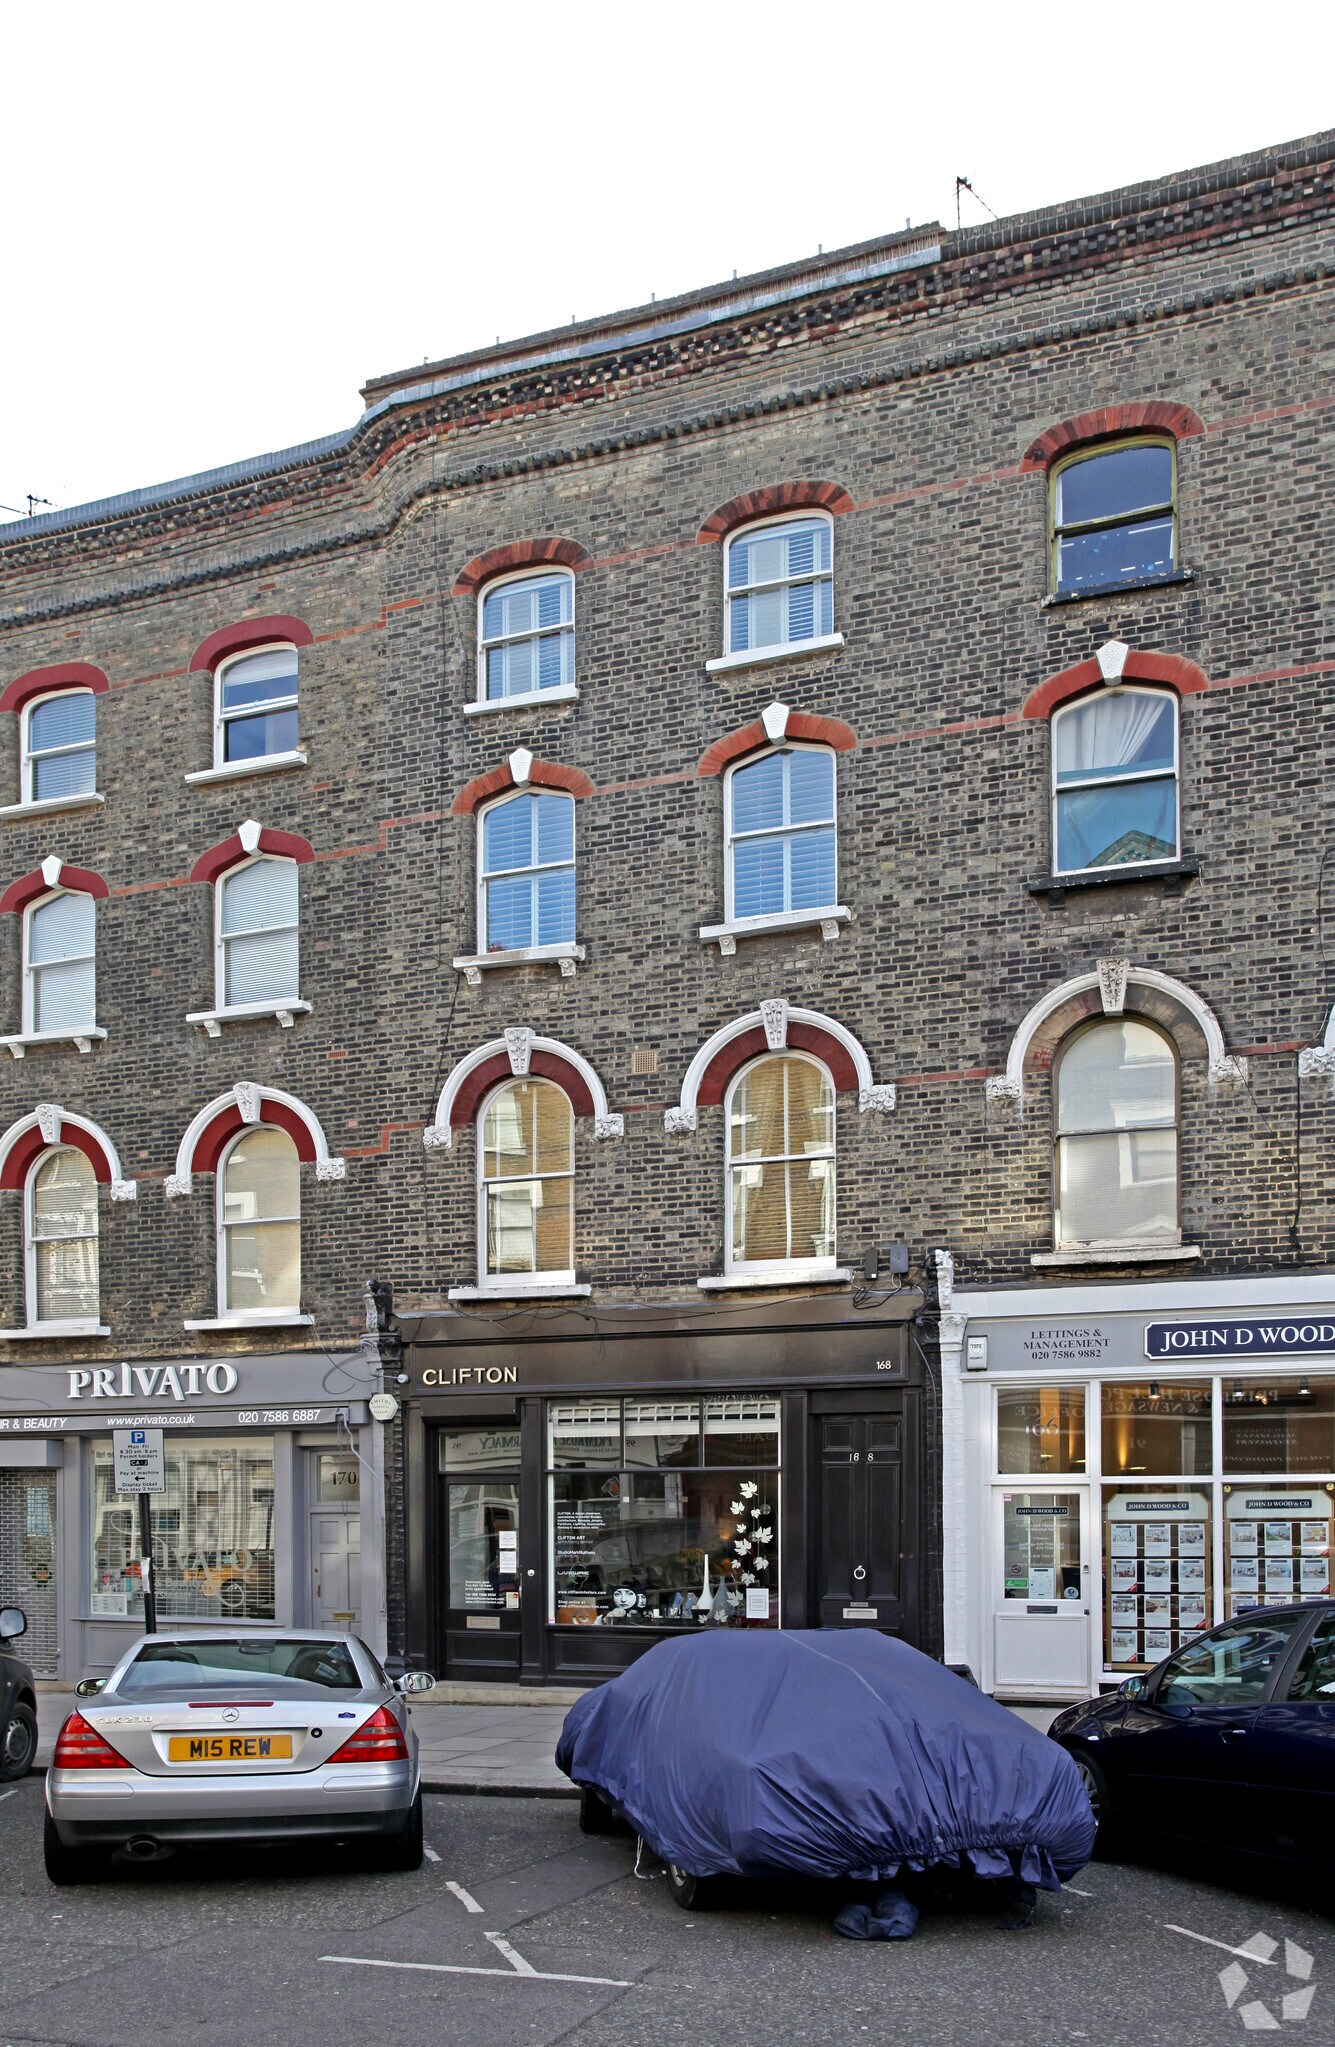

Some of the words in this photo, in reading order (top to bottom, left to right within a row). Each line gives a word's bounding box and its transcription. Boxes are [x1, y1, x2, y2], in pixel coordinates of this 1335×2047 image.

[1031, 1329, 1090, 1339] LETTINGS
[1093, 1328, 1102, 1337] &
[1160, 1329, 1228, 1352] JOHN
[1234, 1328, 1254, 1344] D
[1258, 1325, 1335, 1344] WOOD
[1024, 1338, 1110, 1350] MANAGEMENT
[1032, 1352, 1049, 1360] 020
[1052, 1350, 1075, 1359] 7586
[1078, 1350, 1101, 1358] 9882
[876, 1360, 892, 1370] 168
[66, 1362, 238, 1401] PRIVATO
[422, 1366, 518, 1385] CLIFTON
[106, 1414, 195, 1426] www.privato.co.uk
[238, 1412, 258, 1423] 020
[262, 1411, 289, 1422] 7586
[292, 1410, 320, 1421] 6887
[0, 1418, 10, 1430] IR
[12, 1418, 20, 1430] &
[24, 1418, 68, 1429] BEAUTY
[330, 1471, 357, 1486] 170
[190, 1740, 223, 1757] M15
[230, 1738, 271, 1756] REW
